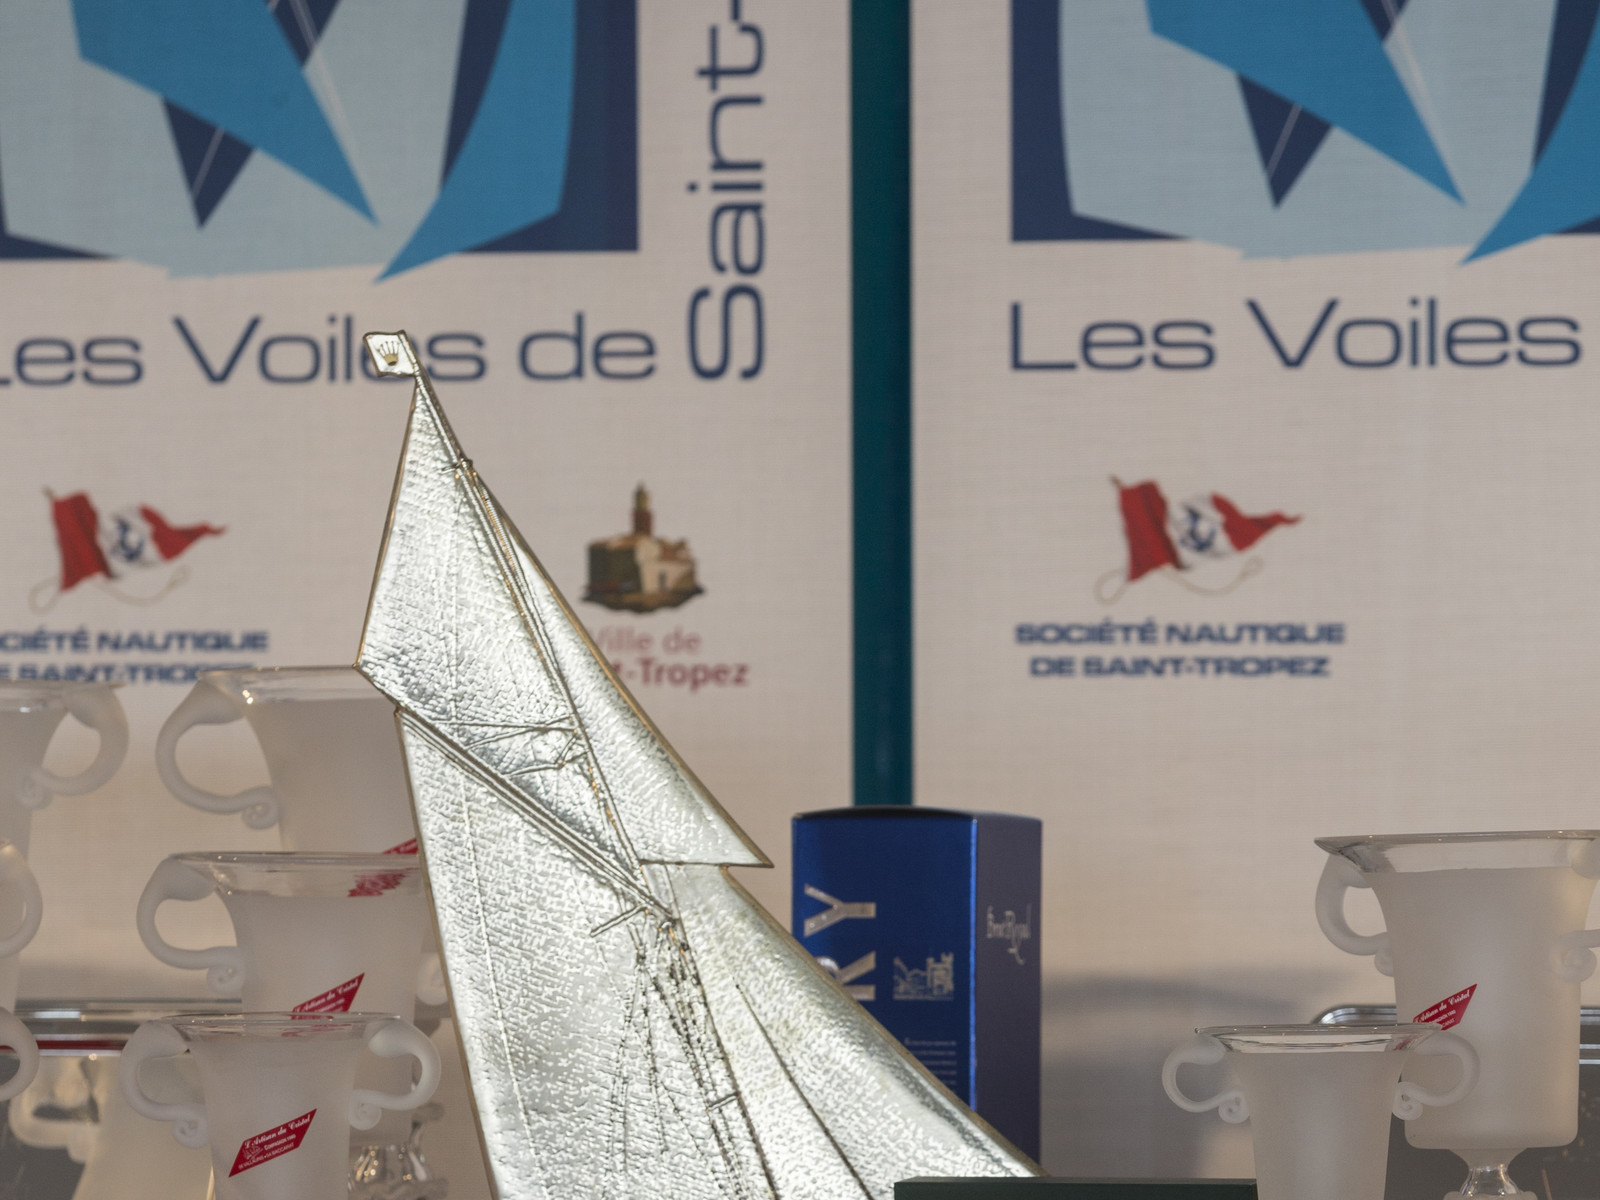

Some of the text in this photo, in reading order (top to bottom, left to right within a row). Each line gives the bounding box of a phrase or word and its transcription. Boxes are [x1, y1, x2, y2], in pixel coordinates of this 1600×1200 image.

[172, 314, 487, 385] Voils
[518, 311, 658, 381] de
[1010, 297, 1582, 372] Les Voiles
[0, 624, 269, 652] CIÉTÉ NAUTIQUE
[662, 624, 702, 654] de
[1014, 618, 1346, 645] SOCIÉTÉ NAUTIQUE
[1029, 655, 1331, 678] DE SAINT-TROPEZ
[288, 1113, 311, 1130] Cristal
